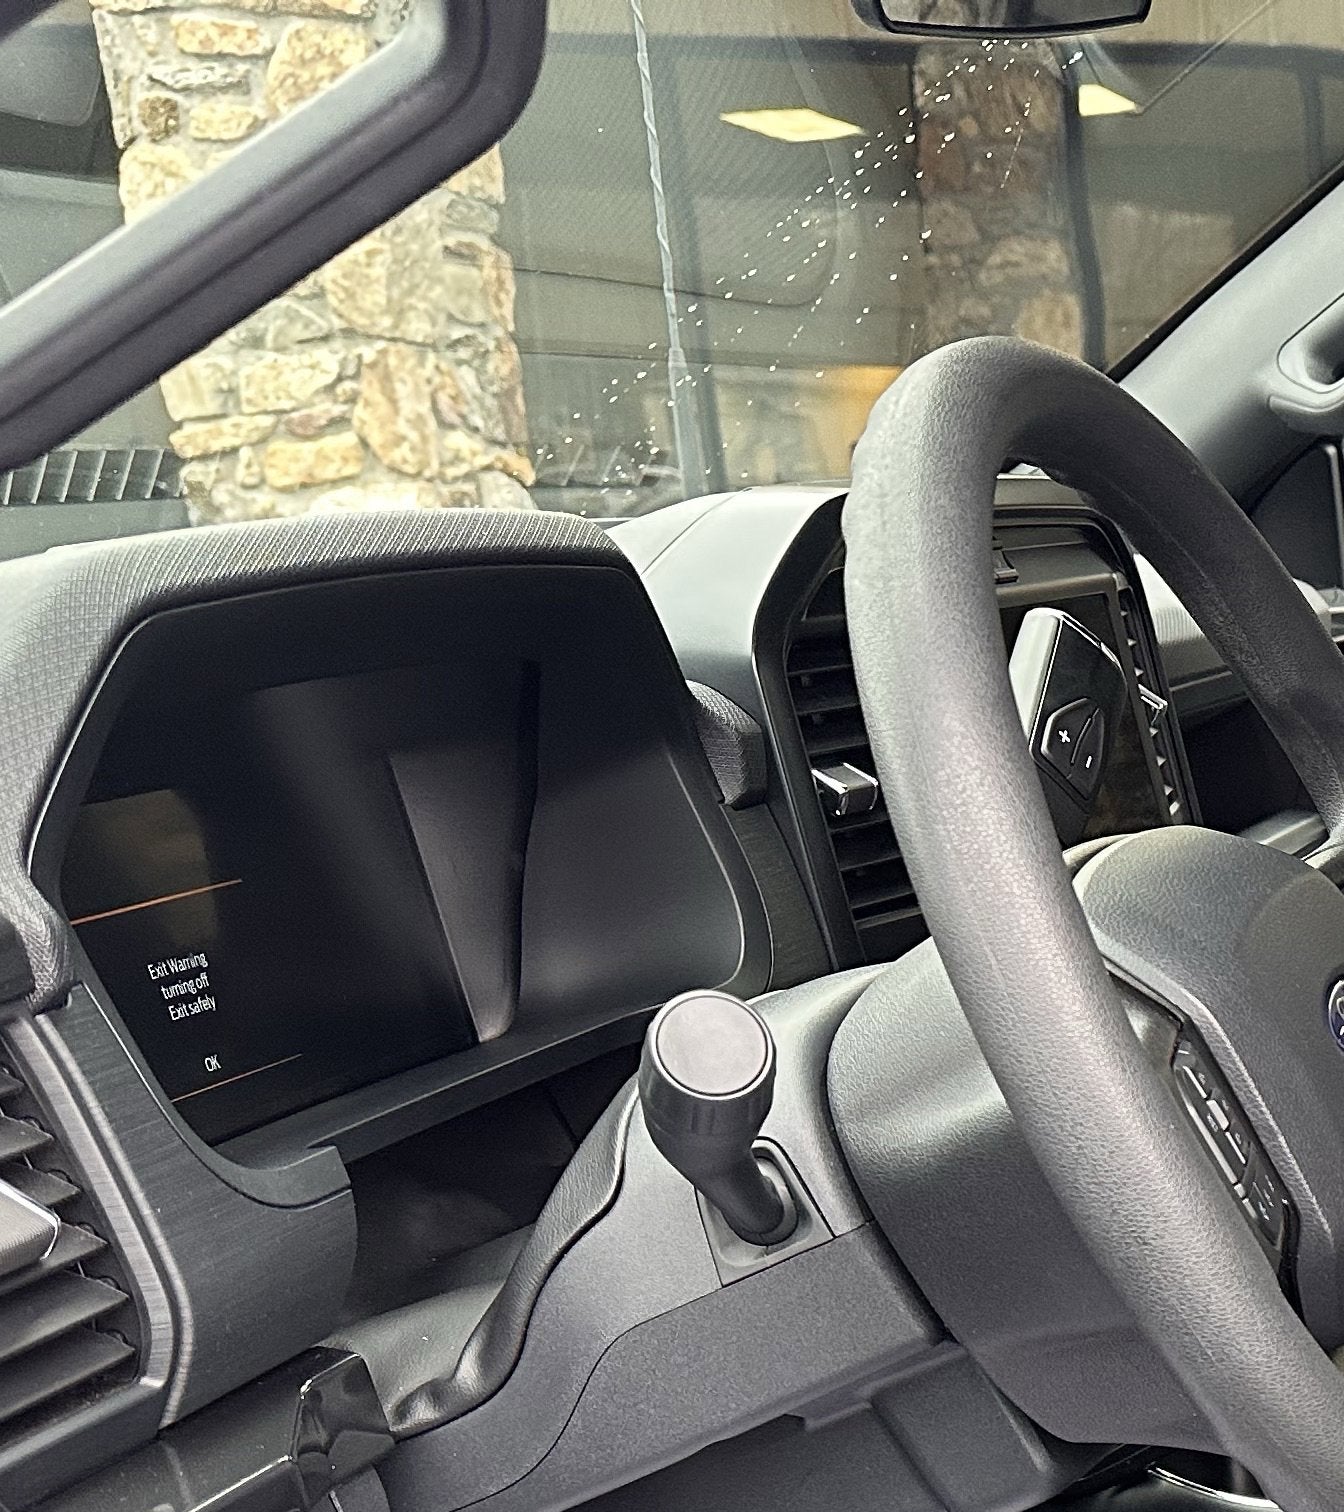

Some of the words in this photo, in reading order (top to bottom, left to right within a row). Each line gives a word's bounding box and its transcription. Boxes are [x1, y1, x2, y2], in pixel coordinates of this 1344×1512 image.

[147, 962, 169, 980] Exit
[166, 953, 208, 975] Warning
[161, 979, 197, 1000] turning
[195, 971, 210, 990] off
[168, 1002, 190, 1021] Exit
[188, 993, 217, 1016] safely
[204, 1054, 222, 1072] OK
